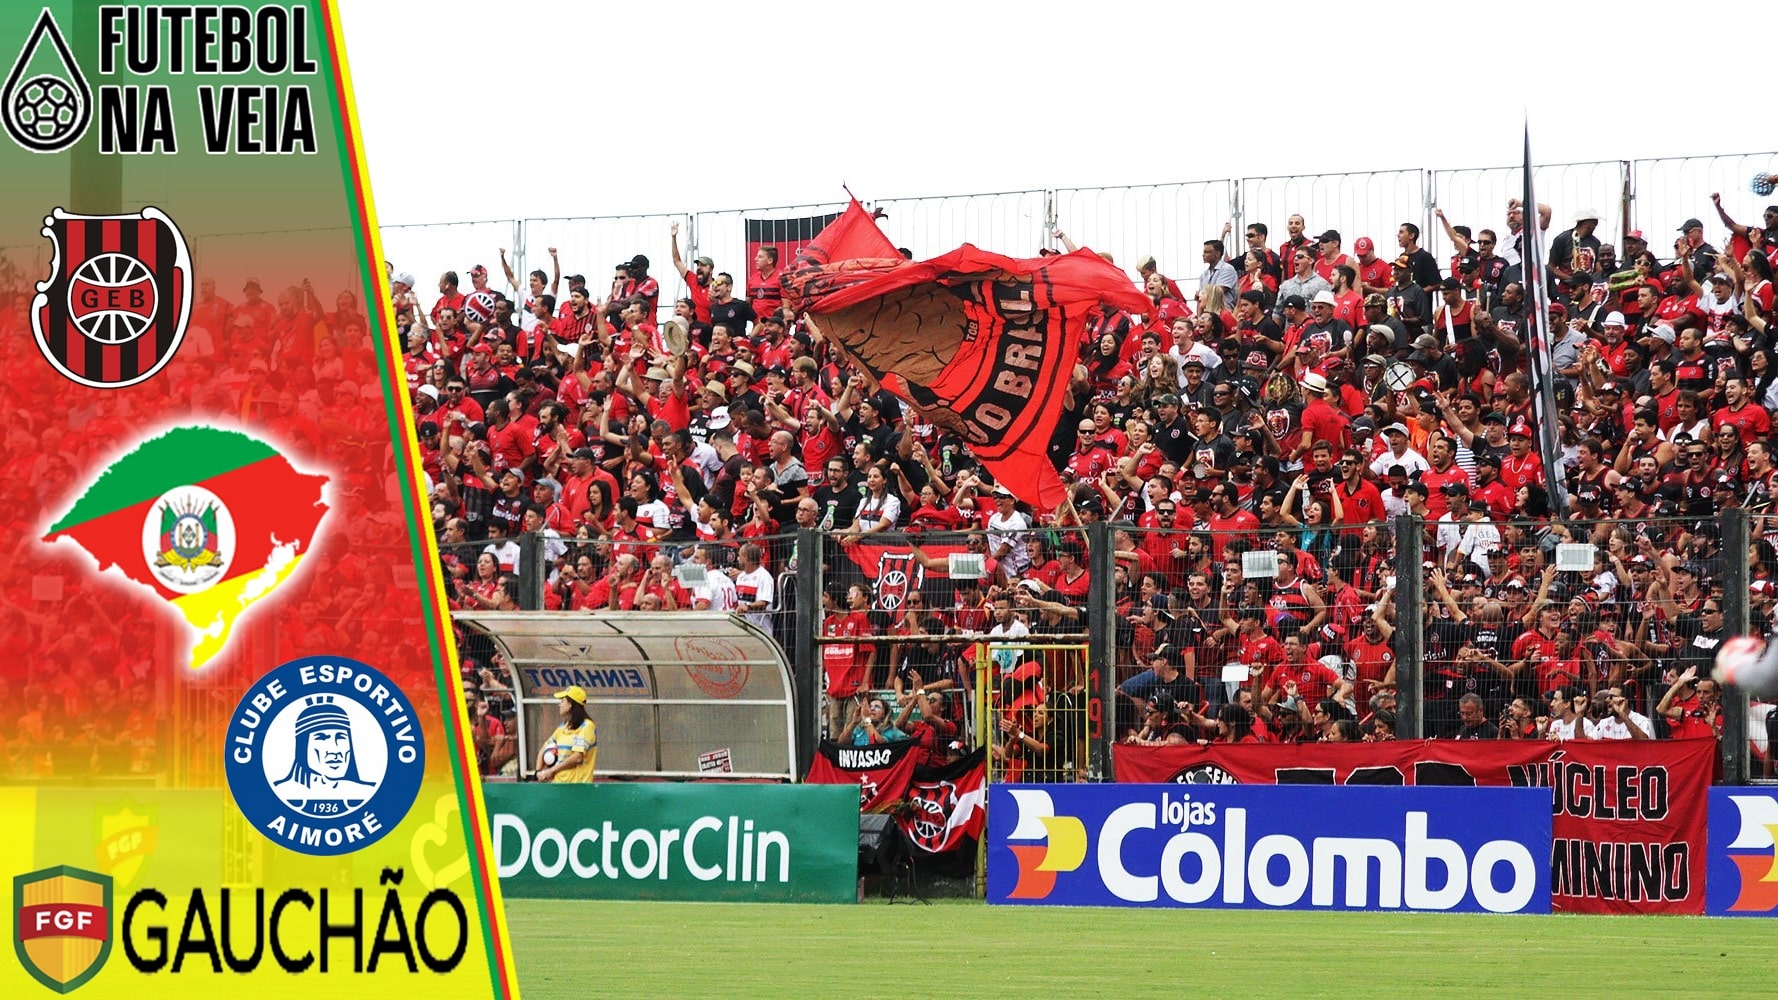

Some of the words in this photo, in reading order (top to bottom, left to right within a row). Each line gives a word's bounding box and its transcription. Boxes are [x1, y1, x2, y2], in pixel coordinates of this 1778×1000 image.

[1161, 792, 1216, 832] lojas
[492, 813, 790, 883] DoctorClin
[1097, 802, 1537, 913] Colombo
